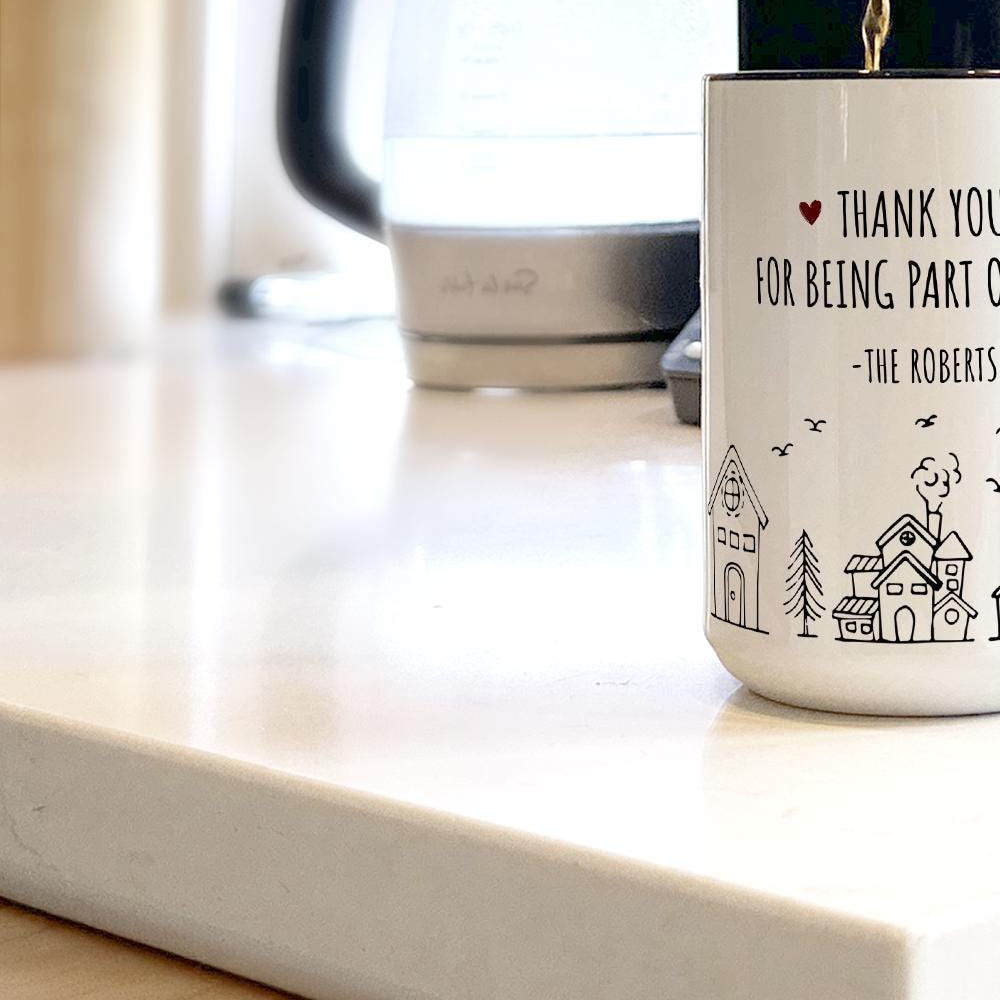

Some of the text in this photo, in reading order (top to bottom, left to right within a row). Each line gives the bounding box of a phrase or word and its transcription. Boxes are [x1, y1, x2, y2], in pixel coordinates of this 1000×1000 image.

[836, 187, 938, 239] THANK
[756, 256, 796, 307] FOR
[806, 258, 895, 310] BEING
[907, 259, 973, 309] PART
[852, 346, 998, 384] -THE ROBERTS
